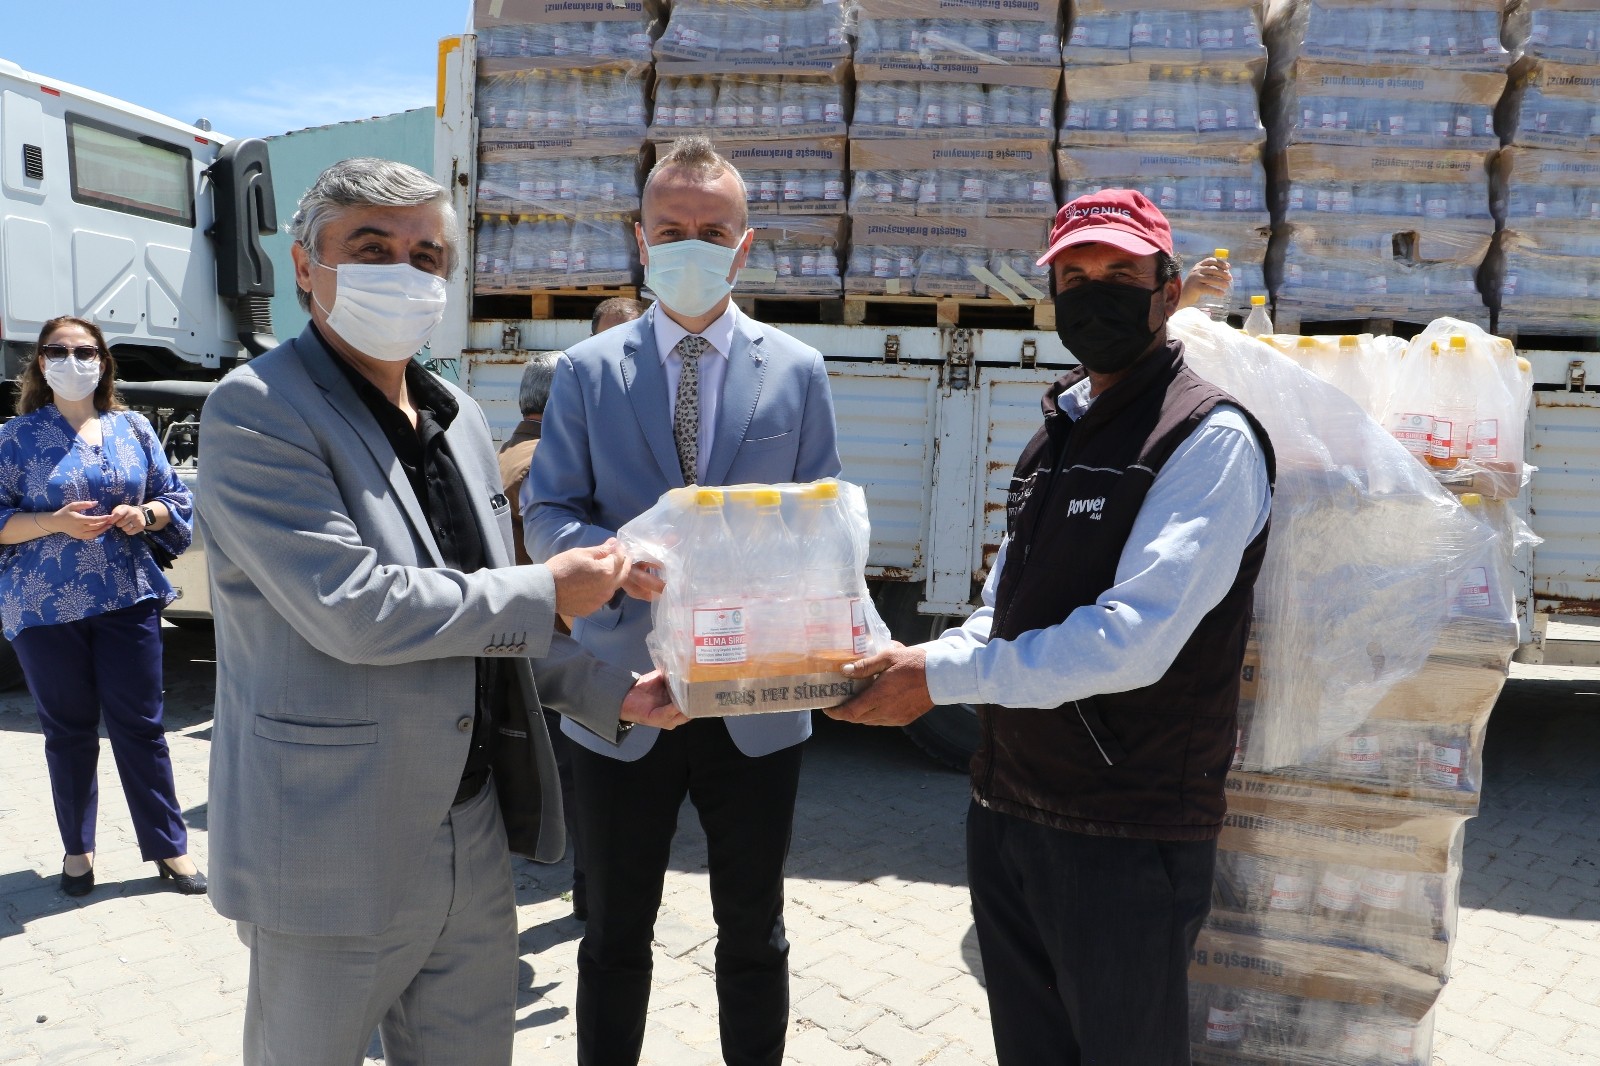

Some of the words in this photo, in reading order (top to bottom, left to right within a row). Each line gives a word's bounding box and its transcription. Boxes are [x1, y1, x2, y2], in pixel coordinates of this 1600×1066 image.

[1321, 76, 1384, 89] Bırakmayınız!
[1386, 79, 1425, 91] Güneşte
[1547, 76, 1600, 87] akmayınız!
[731, 149, 792, 160] Bırakmayınız!
[795, 147, 833, 160] Güneşte
[932, 149, 994, 160] Bırakmayınız!
[996, 148, 1033, 161] Güneşte
[1073, 206, 1131, 219] CYGNUS
[868, 224, 928, 237] Bırakmayınız!
[930, 224, 968, 238] Güneşte
[703, 637, 727, 646] ELMA
[761, 686, 789, 703] PET
[794, 680, 856, 700] SİRKESİ
